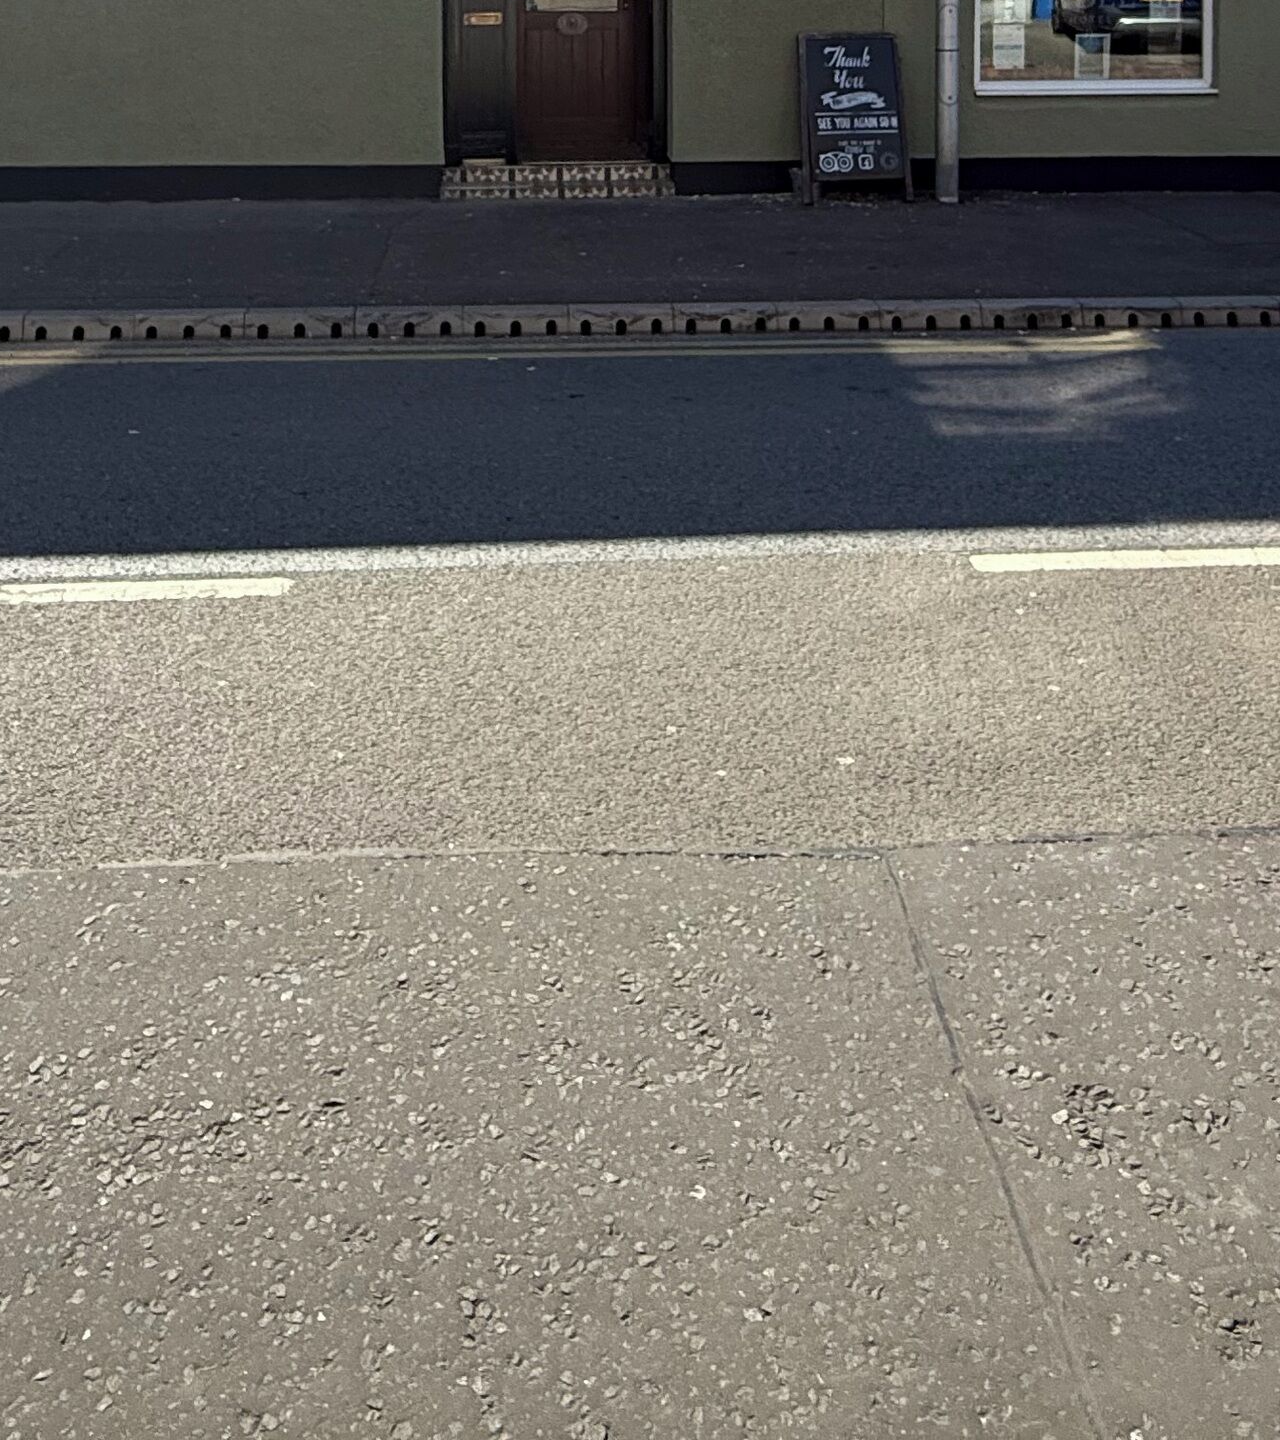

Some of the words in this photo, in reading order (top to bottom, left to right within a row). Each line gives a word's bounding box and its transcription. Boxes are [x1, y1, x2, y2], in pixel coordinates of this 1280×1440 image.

[823, 45, 871, 68] Thank
[834, 69, 864, 89] You
[817, 117, 832, 129] SEE
[834, 117, 850, 129] YOU
